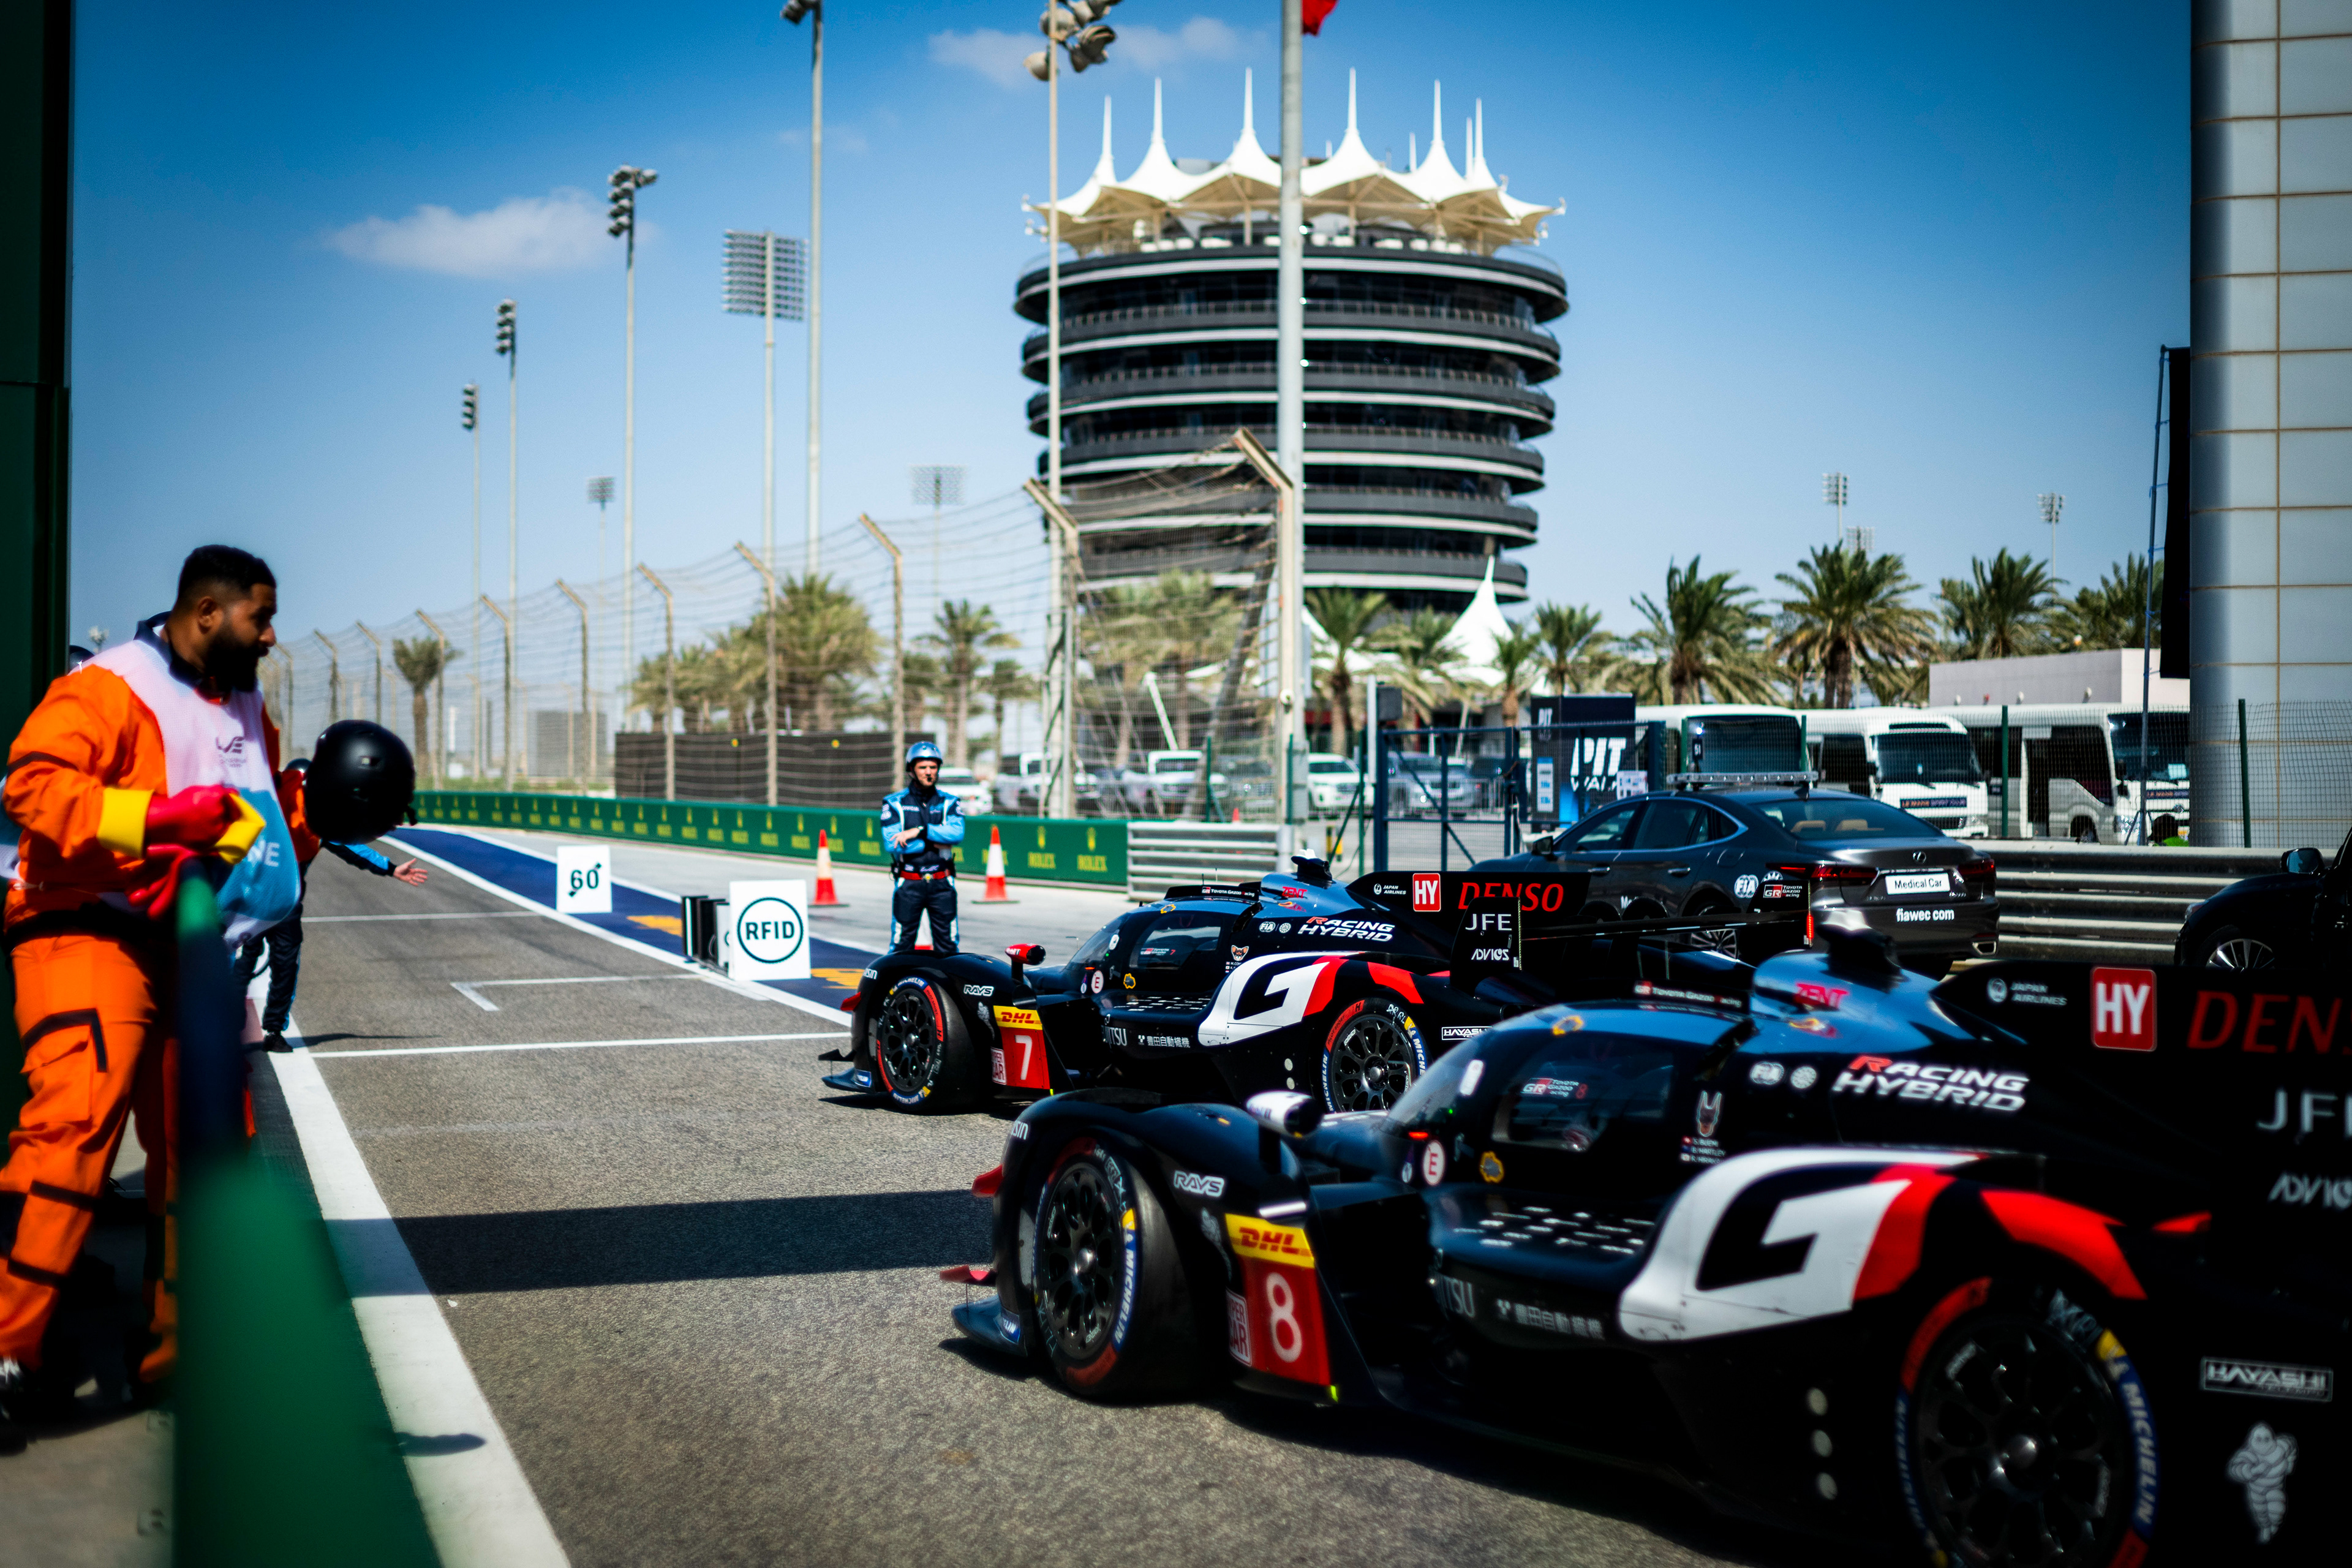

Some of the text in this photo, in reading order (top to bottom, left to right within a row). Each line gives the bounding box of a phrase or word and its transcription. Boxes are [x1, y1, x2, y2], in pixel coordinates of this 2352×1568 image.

[1570, 737, 1627, 777] PIT
[1077, 855, 1107, 872] ROLEX
[570, 870, 600, 889] 60
[1894, 878, 1942, 889] Medical Car
[1282, 886, 1308, 899] ZENT
[1414, 880, 1438, 905] HY
[745, 921, 795, 940] RFID
[1306, 916, 1395, 933] RACING
[1465, 913, 1512, 931] JFE
[1297, 924, 1393, 942] HYBRID
[963, 984, 994, 997] RAYS
[1095, 977, 1100, 989] E
[1652, 987, 1685, 998] TOYOTA
[2010, 982, 2049, 993] JAPAN
[1355, 1002, 1362, 1012] H
[2011, 994, 2068, 1006] AIRLINES
[2096, 982, 2151, 1035] HY
[1001, 1011, 1035, 1024] DHL
[937, 1029, 942, 1038] H
[1014, 1035, 1033, 1080] 7
[1322, 1054, 1334, 1112] MICHELIN
[1848, 1055, 2030, 1092] RACING
[1523, 1083, 1547, 1094] GR
[1575, 1083, 1588, 1099] 8
[1831, 1072, 2026, 1111] HYBRID
[1429, 1153, 1439, 1176] E
[1174, 1170, 1225, 1197] RAYS
[1238, 1226, 1300, 1254] DHL
[1114, 1250, 1134, 1344] MICHELIN
[1265, 1272, 1303, 1363] 8
[2206, 1364, 2326, 1392] HAYASHI
[2121, 1381, 2158, 1524] MICHELIN
